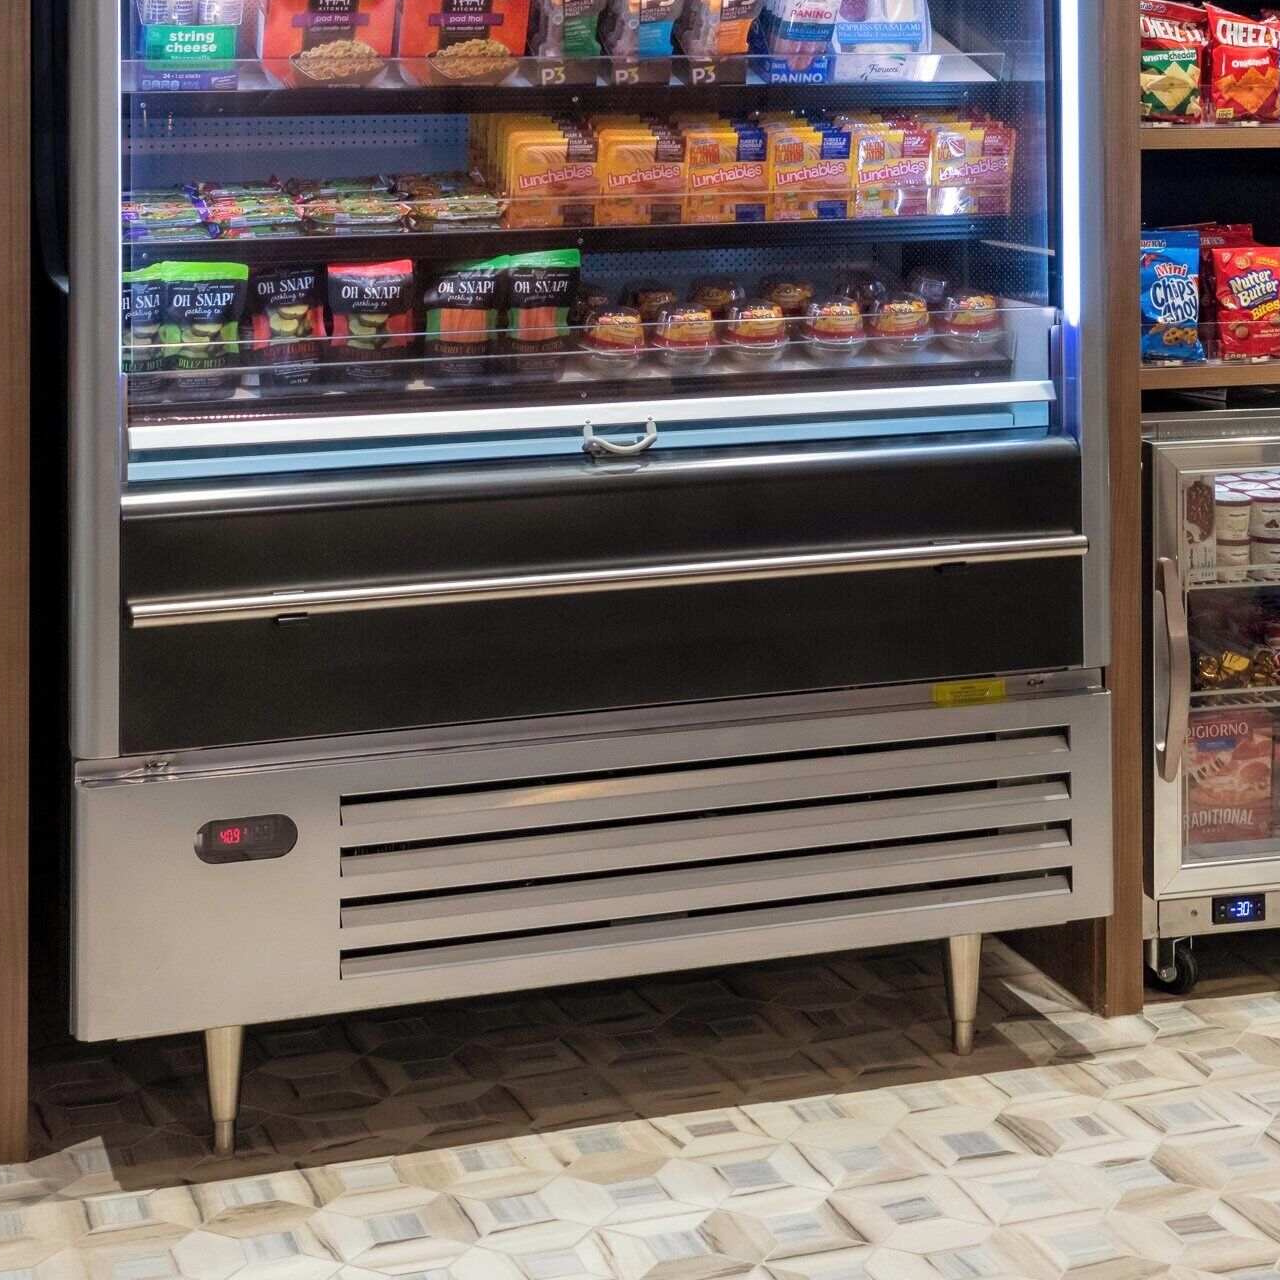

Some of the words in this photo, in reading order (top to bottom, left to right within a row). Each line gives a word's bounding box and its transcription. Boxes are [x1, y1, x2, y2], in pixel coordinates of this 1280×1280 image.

[314, 14, 333, 25] pad
[334, 14, 349, 22] thai
[449, 15, 468, 25] pad
[470, 14, 483, 23] thai
[790, 9, 833, 20] PANINO
[169, 31, 215, 43] string
[165, 42, 217, 53] cheese
[1169, 50, 1196, 61] cheddar
[771, 72, 823, 84] PANINO
[519, 164, 593, 191] Lunchables
[607, 164, 680, 189] Lunchables
[691, 164, 762, 188] Lunchables
[1154, 263, 1187, 277] Mini
[258, 282, 275, 295] OH
[280, 277, 315, 291] SNAP!
[1229, 270, 1271, 293] Nutter
[1152, 277, 1195, 308] Chips
[1238, 279, 1279, 306] Butter
[173, 296, 190, 308] OH
[195, 293, 234, 306] SNAP!
[1251, 300, 1280, 320] Bites
